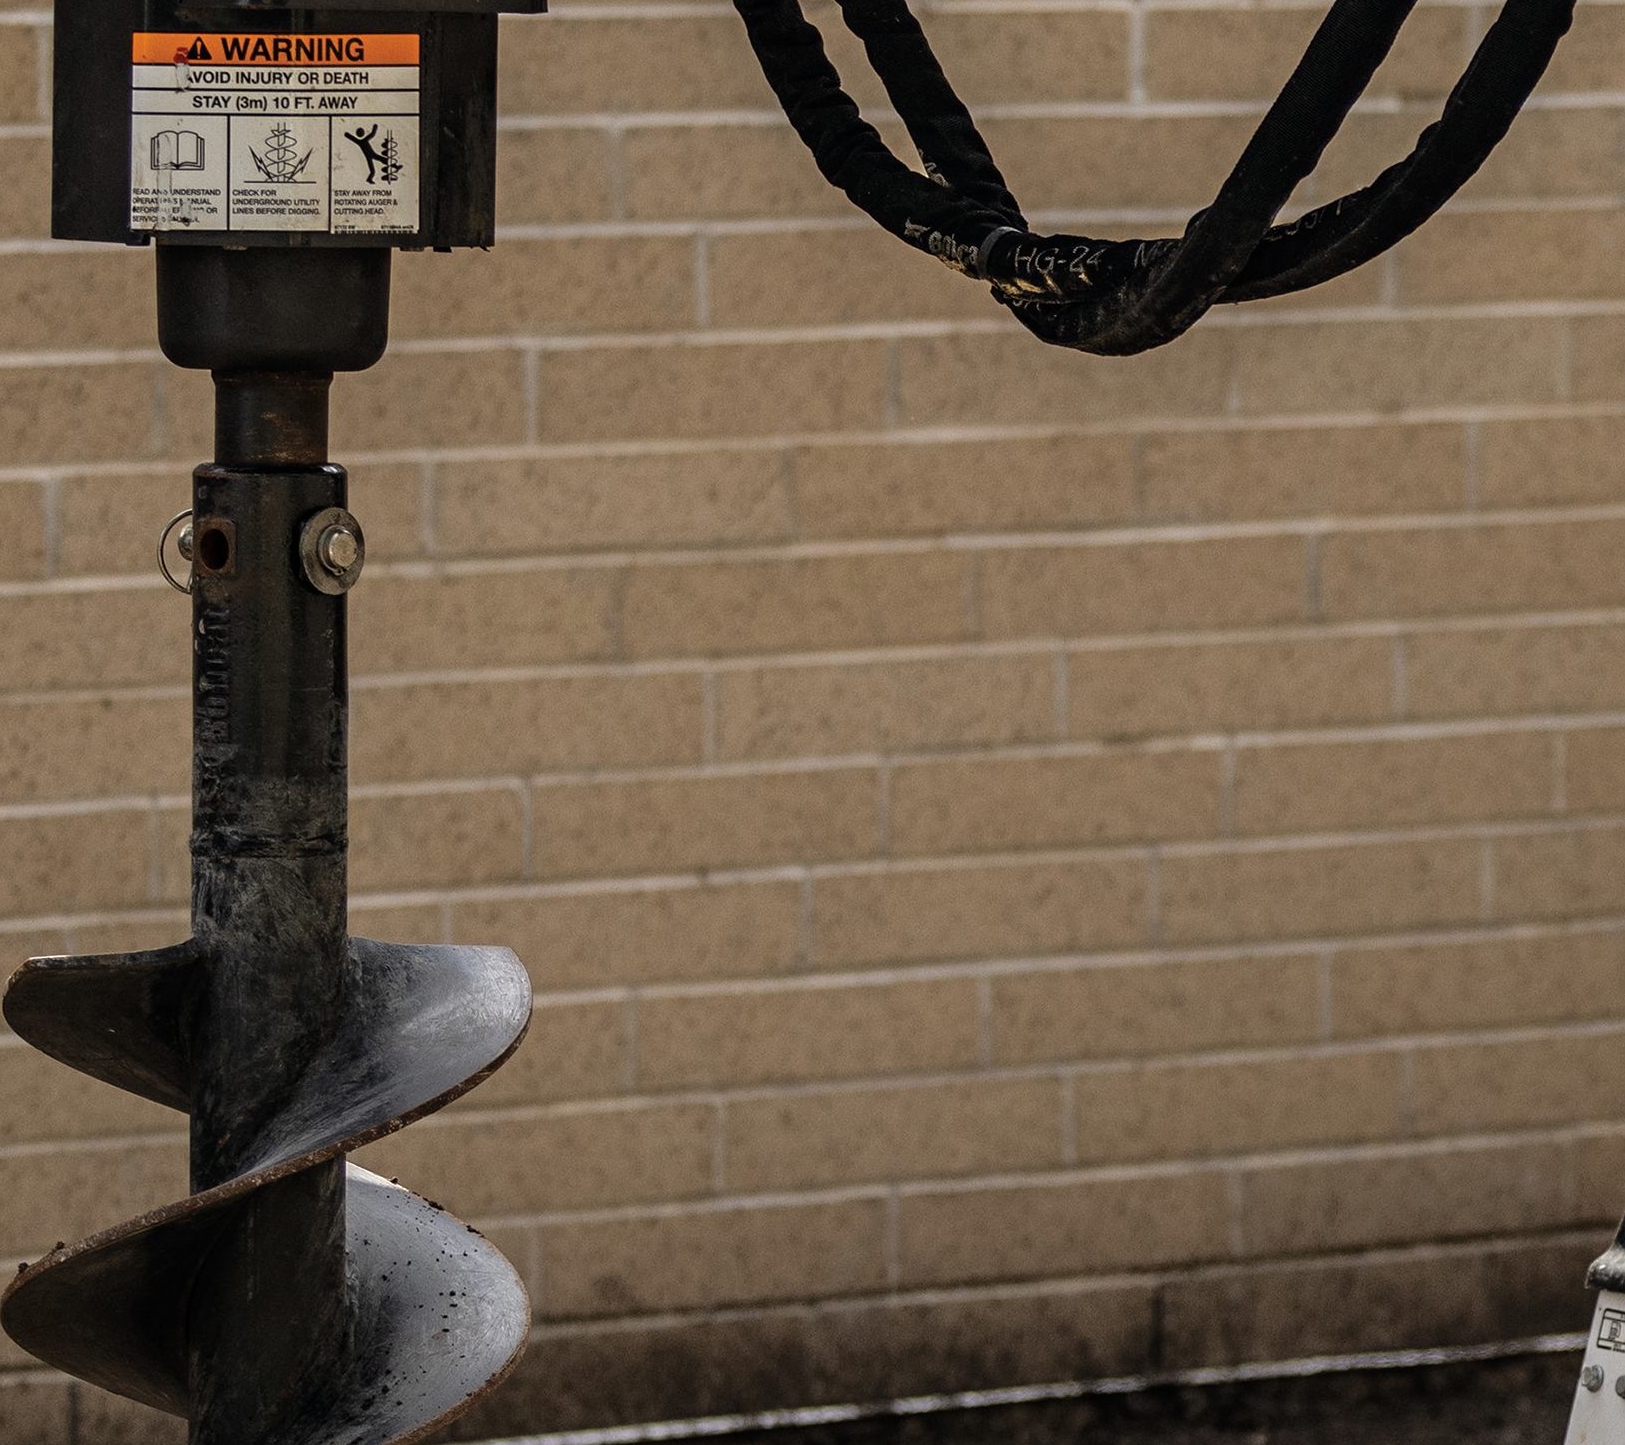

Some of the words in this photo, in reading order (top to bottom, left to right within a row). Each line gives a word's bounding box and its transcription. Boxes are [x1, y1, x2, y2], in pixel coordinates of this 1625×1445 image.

[221, 37, 365, 62] WARNING
[235, 71, 293, 84] INJURY
[297, 72, 320, 85] OR
[323, 72, 369, 85] DEATH
[192, 95, 232, 109] STAY
[236, 96, 268, 111] (3m)
[273, 97, 290, 109] 10
[294, 97, 315, 109] FT.
[318, 97, 358, 109] AWAY
[171, 188, 222, 196] UNDERSTAND
[232, 198, 292, 206] UNDERGROUND
[206, 207, 219, 215] OR
[232, 207, 255, 215] LINES
